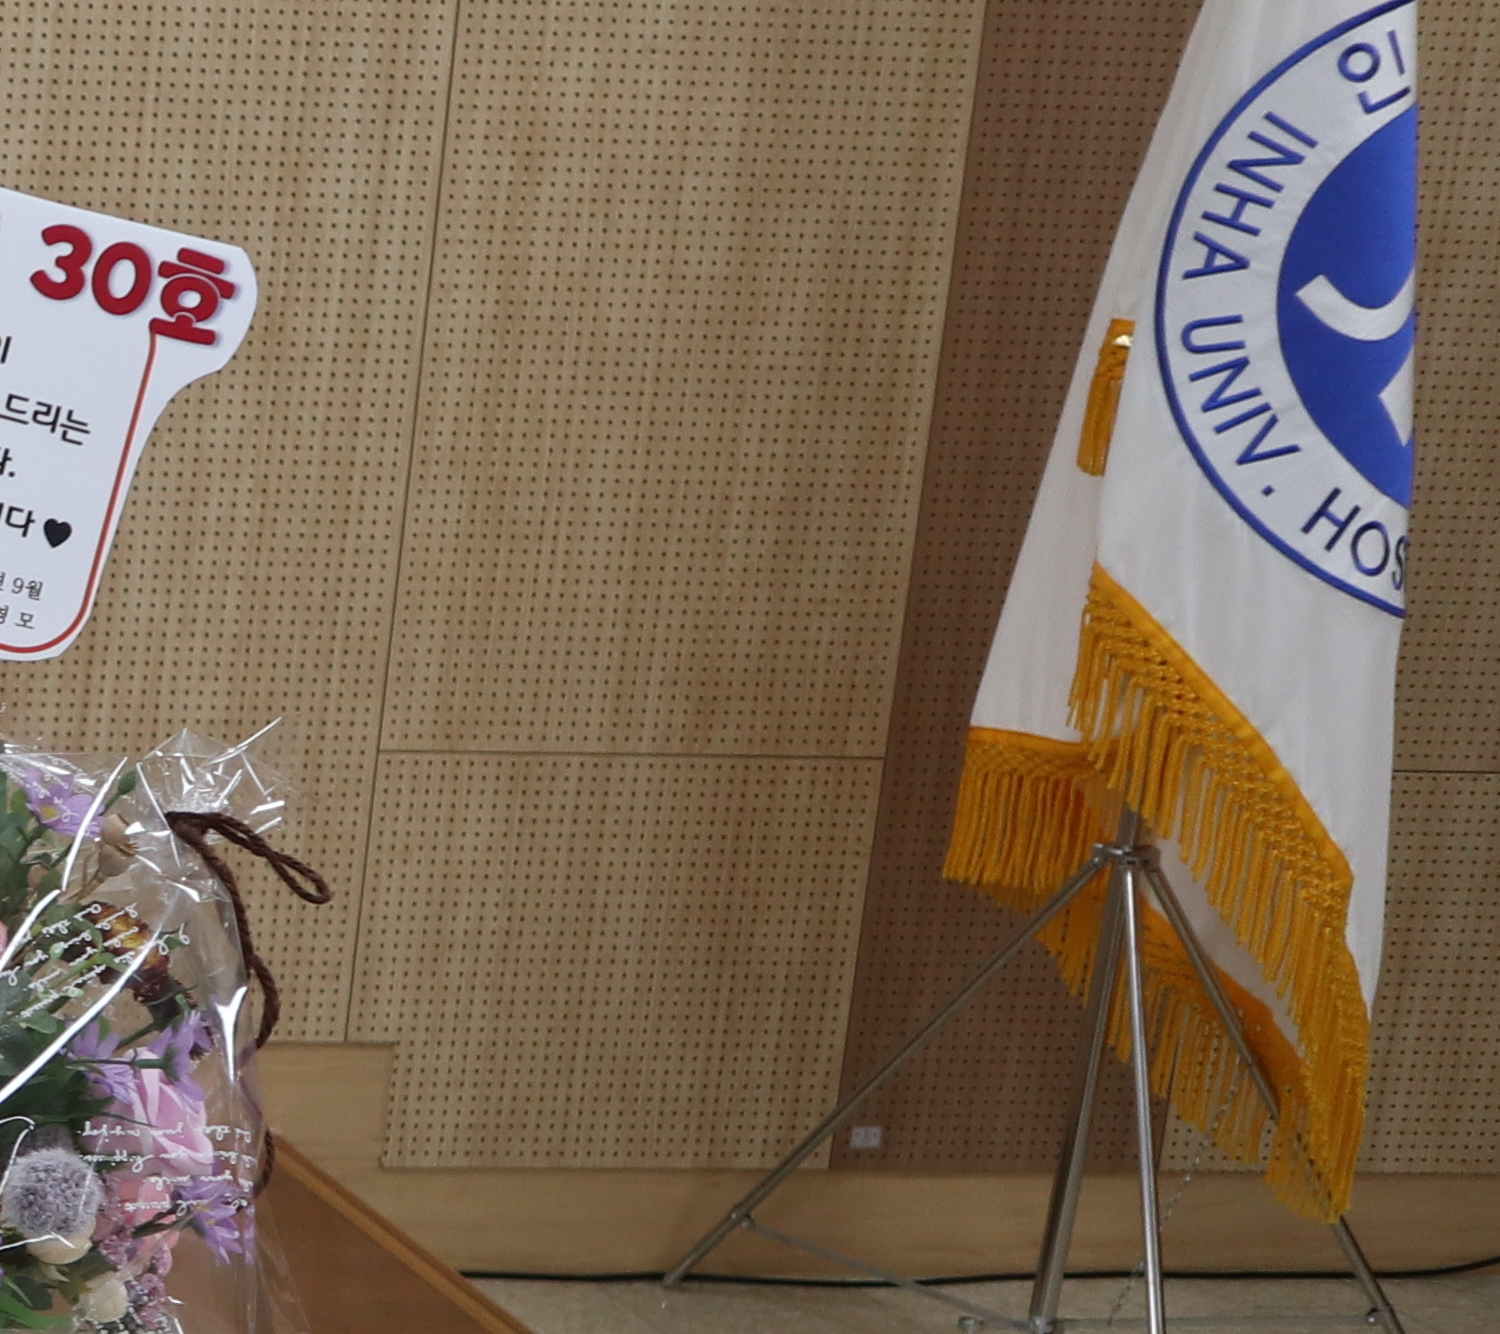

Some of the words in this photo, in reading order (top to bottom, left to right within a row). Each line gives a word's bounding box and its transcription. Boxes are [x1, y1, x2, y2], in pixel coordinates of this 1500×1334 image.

[1181, 111, 1319, 281] INHA
[30, 224, 235, 345] 30호
[11, 578, 43, 600] 9월
